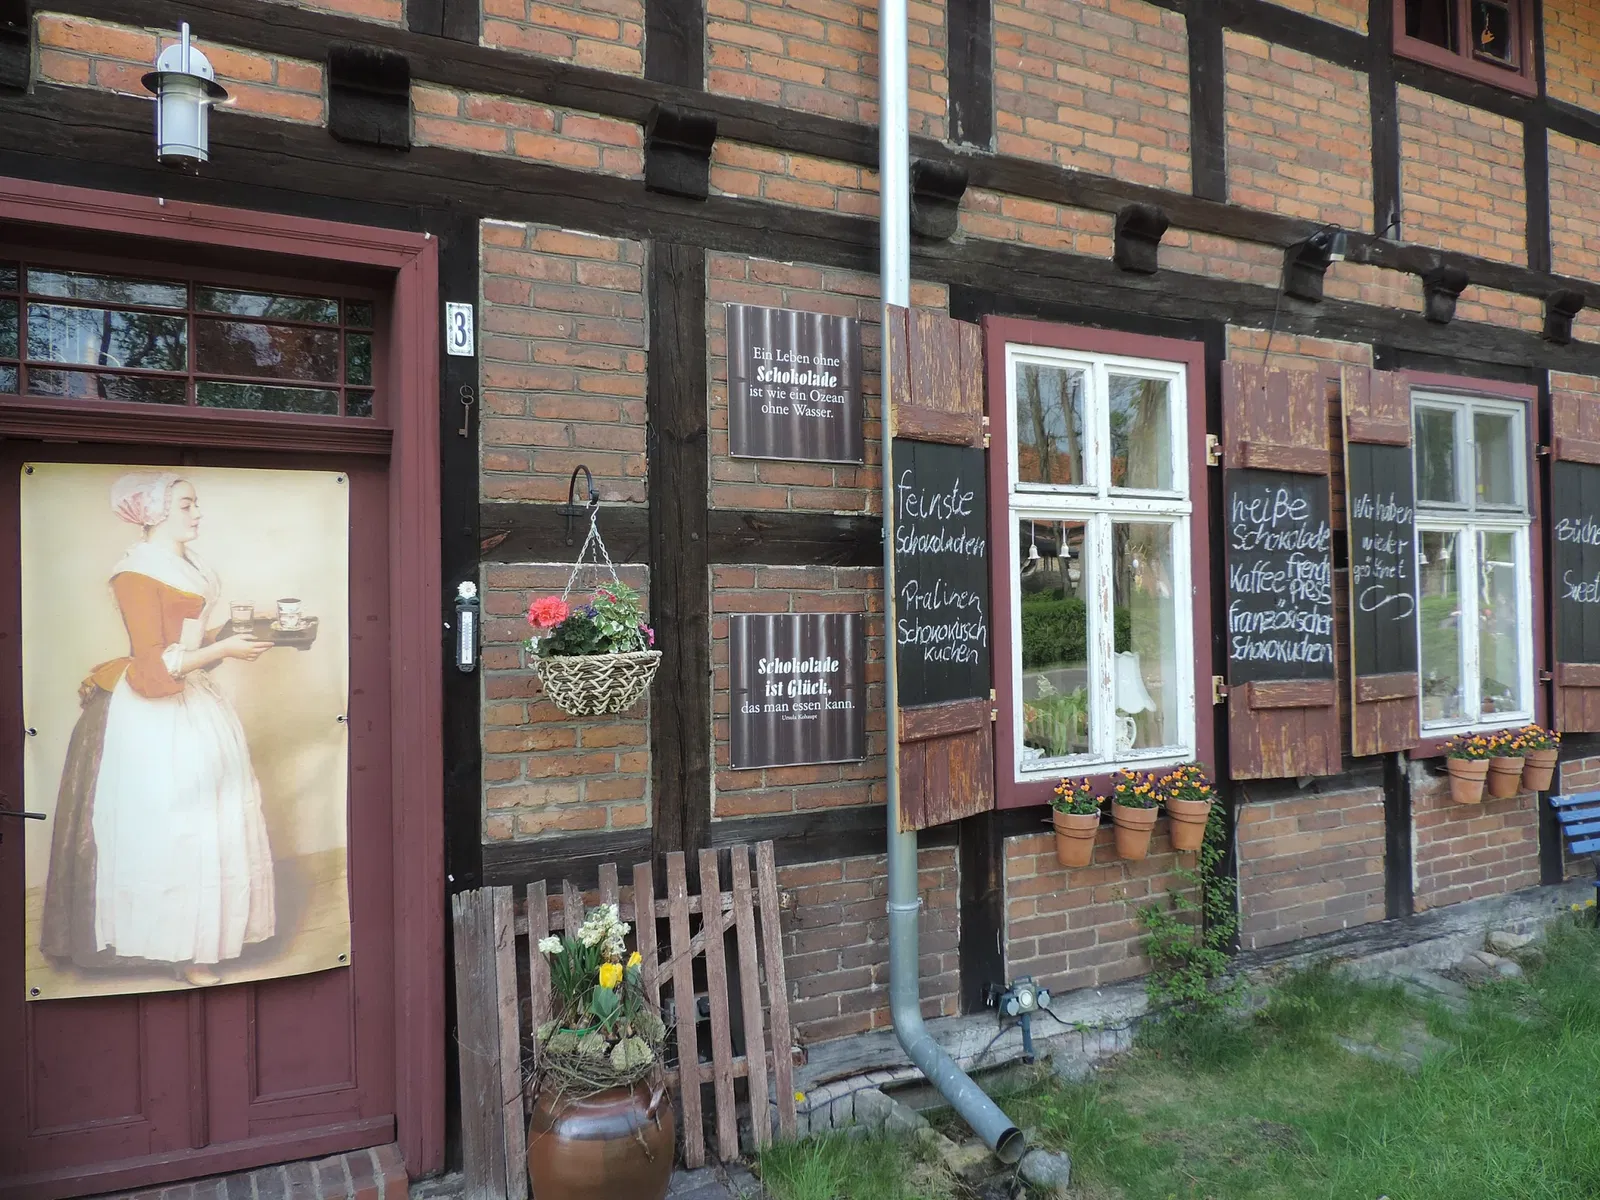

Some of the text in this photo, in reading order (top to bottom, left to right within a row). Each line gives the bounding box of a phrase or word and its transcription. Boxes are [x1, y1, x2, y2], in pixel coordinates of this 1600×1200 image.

[454, 311, 467, 347] 3
[753, 346, 840, 367] Ein Leben ohne
[756, 365, 837, 388] Schokolade
[750, 384, 845, 404] ist wie ein Ozean
[761, 402, 834, 418] ohne Wasser.
[1232, 488, 1309, 528] heiße
[1232, 521, 1330, 552] Schokolade
[1230, 560, 1285, 594] Kaffee
[901, 578, 983, 613] Pralinen
[758, 656, 839, 675] Schokolade
[765, 678, 832, 699] ist Glück,
[741, 697, 855, 714] das man essen kann.
